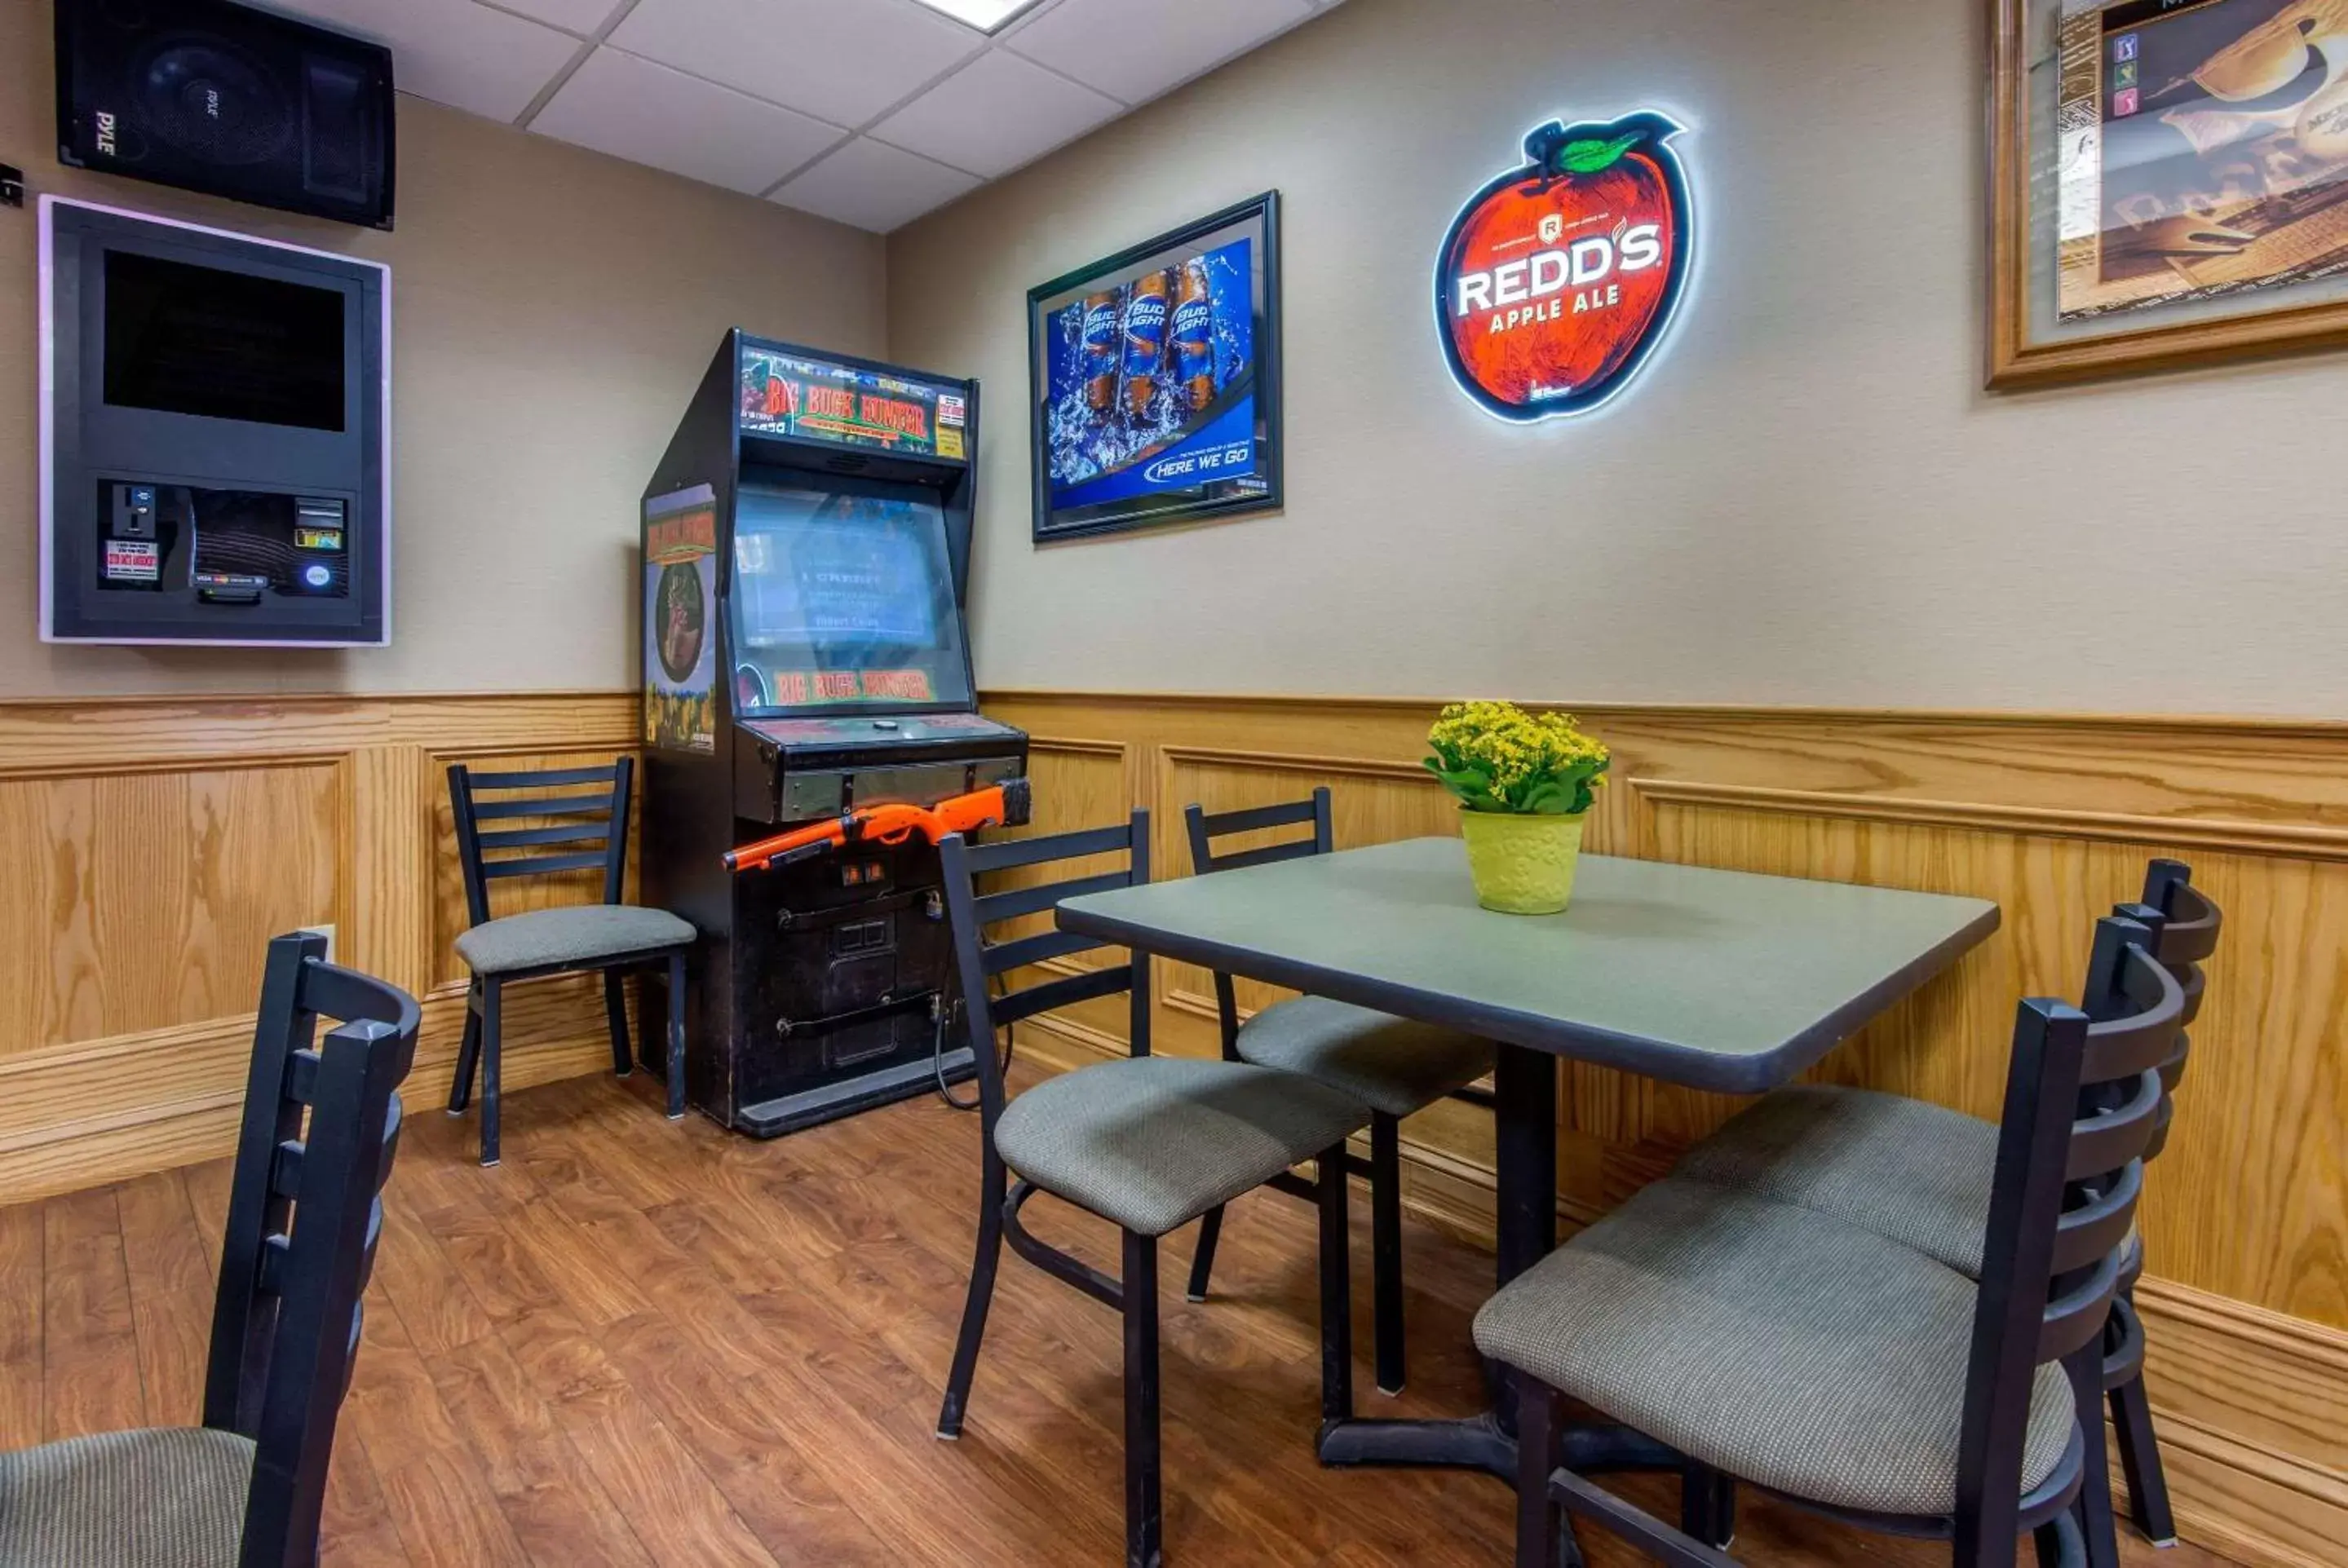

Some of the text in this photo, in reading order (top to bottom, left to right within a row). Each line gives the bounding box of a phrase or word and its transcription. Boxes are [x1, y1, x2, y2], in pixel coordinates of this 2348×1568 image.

[96, 110, 116, 156] PYLE
[1544, 221, 1557, 235] R
[1457, 217, 1661, 316] REDD'S
[1089, 310, 1116, 325] BUD
[1133, 303, 1165, 316] BUD
[1177, 306, 1208, 320] BUD
[1490, 285, 1620, 335] APPLE ALE
[1085, 320, 1117, 337] LIGHT
[1126, 316, 1165, 328] LIGHT
[1171, 316, 1212, 337] LIGHT
[767, 377, 799, 415] BIG
[807, 385, 855, 418] BUCK
[861, 395, 928, 439] HUNTER
[1156, 459, 1195, 478] HERE
[1199, 453, 1222, 470] WE
[1224, 448, 1249, 465] GO
[777, 669, 932, 704] BIG BUCK HUNTER
